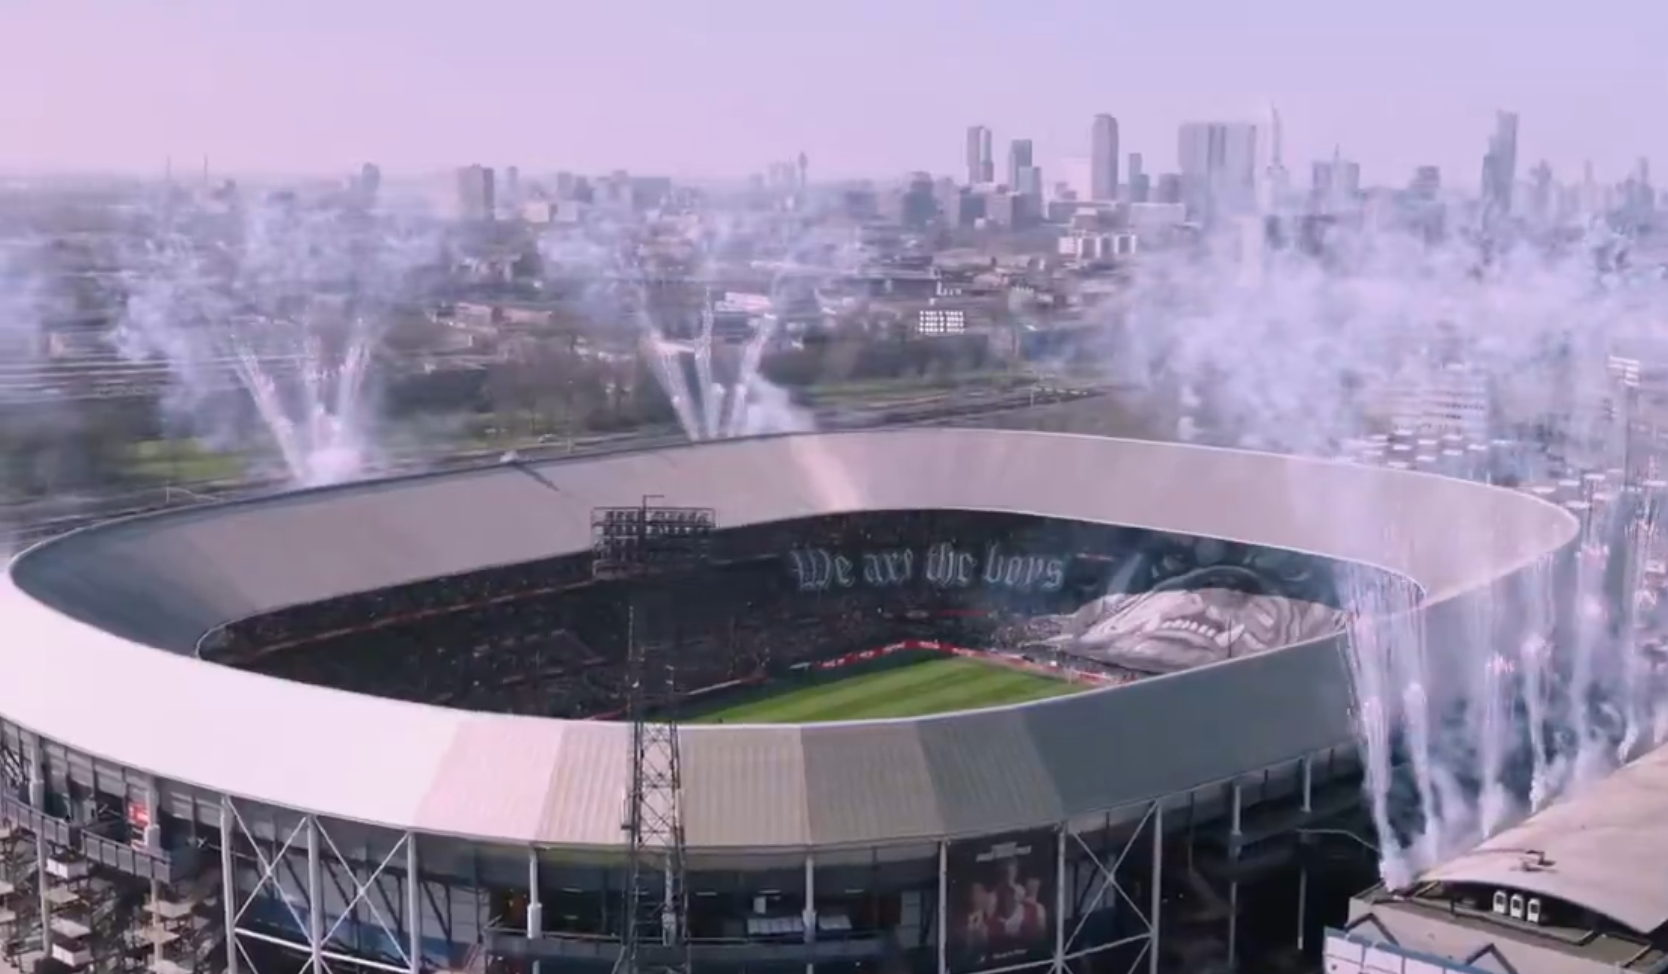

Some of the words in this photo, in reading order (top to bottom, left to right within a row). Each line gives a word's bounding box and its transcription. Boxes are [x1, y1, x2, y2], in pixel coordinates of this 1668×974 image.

[790, 543, 855, 590] We
[926, 541, 977, 588] the
[984, 540, 1065, 590] boys
